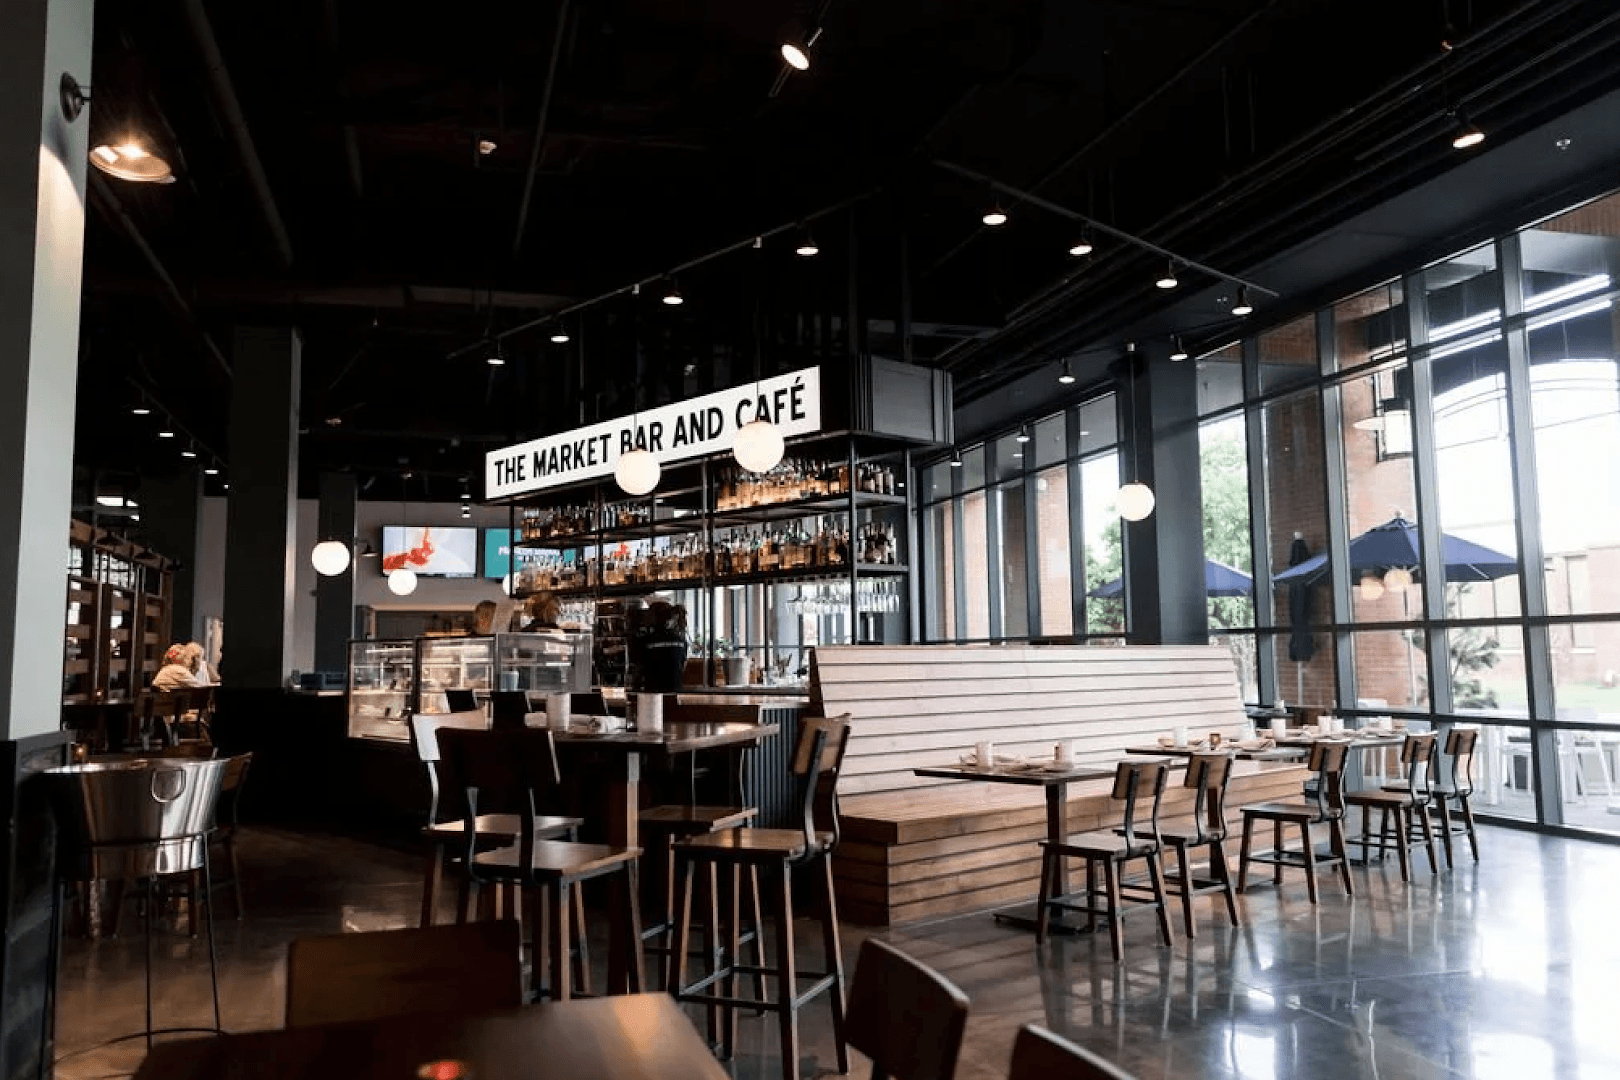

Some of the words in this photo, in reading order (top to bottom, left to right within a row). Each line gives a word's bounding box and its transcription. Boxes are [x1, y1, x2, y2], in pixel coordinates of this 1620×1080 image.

[494, 454, 526, 486] THE
[533, 433, 612, 479] MARKET
[620, 421, 663, 455] BAR
[672, 406, 724, 448] AND
[735, 376, 805, 430] CAFÉ
